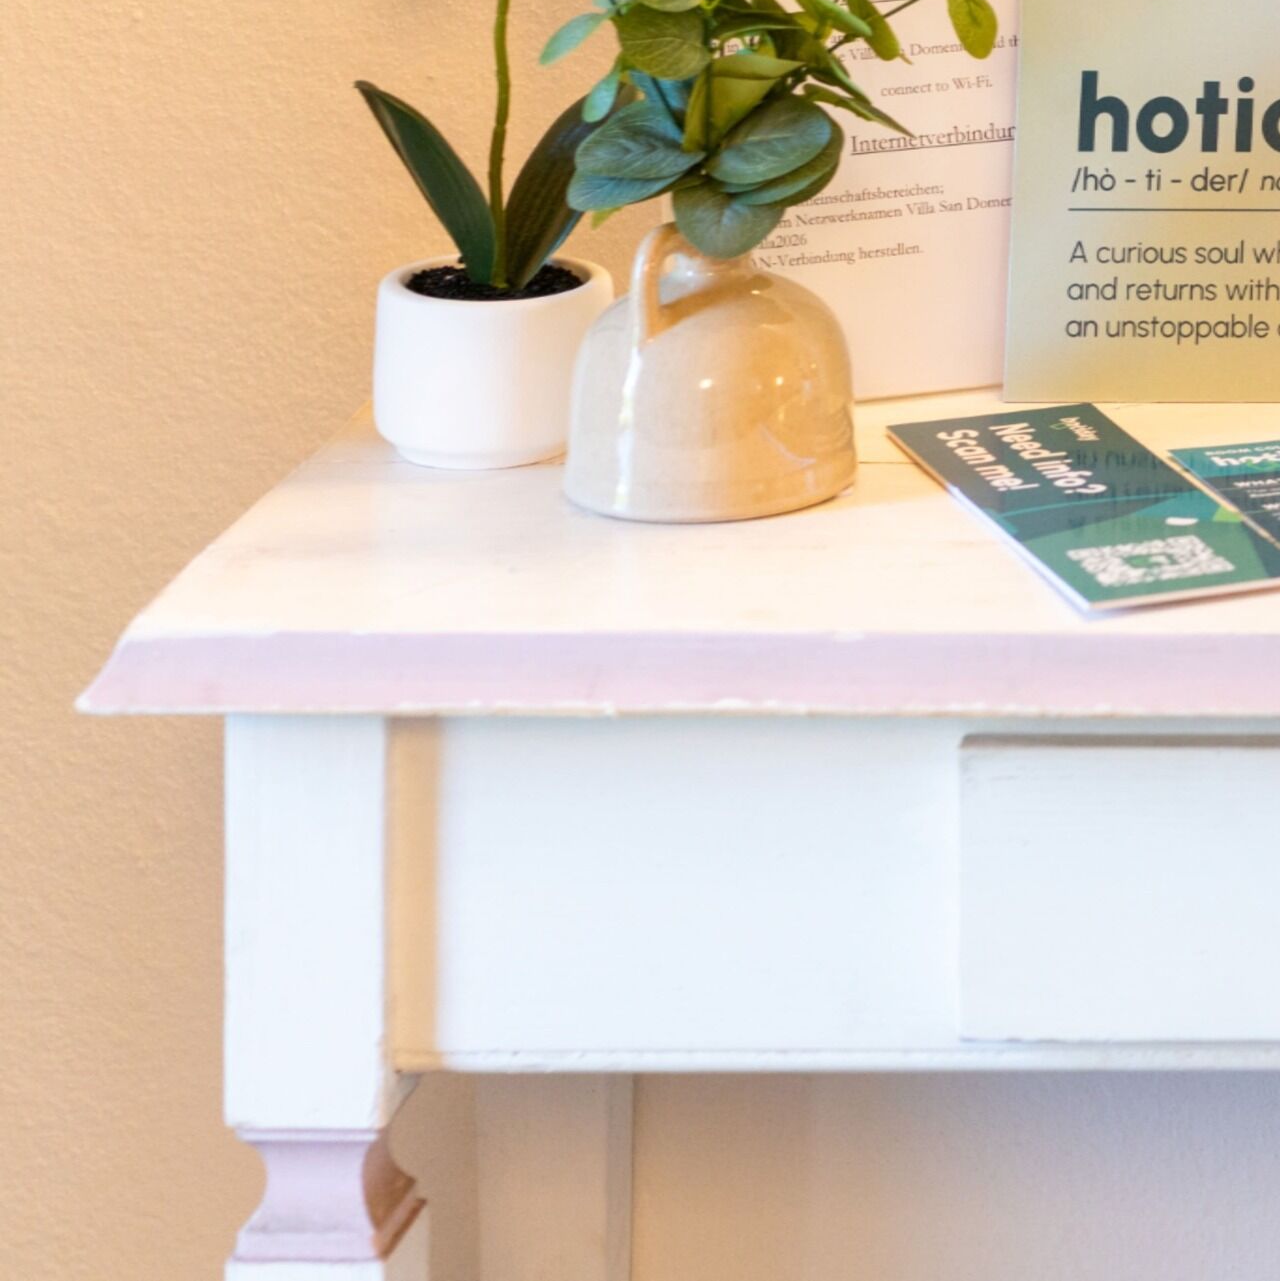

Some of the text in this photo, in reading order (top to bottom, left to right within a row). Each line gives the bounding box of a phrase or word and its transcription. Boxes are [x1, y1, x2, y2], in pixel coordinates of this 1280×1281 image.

[880, 82, 934, 97] connect
[936, 81, 950, 92] to
[1071, 167, 1117, 193] /hò
[1146, 169, 1162, 192] ti
[1190, 168, 1249, 194] der/
[796, 209, 903, 227] Netzwerknamen
[906, 202, 935, 216] Villa
[939, 199, 963, 213] San
[1069, 240, 1088, 264] A
[1096, 242, 1187, 264] curious
[1194, 240, 1245, 264] soul
[1066, 276, 1118, 301] and
[1126, 279, 1218, 301] returns
[1226, 277, 1280, 301] with
[1065, 319, 1099, 339] an
[1105, 314, 1270, 346] unstoppable
[936, 429, 1040, 492] Scan me!
[988, 422, 1108, 495] Need info?
